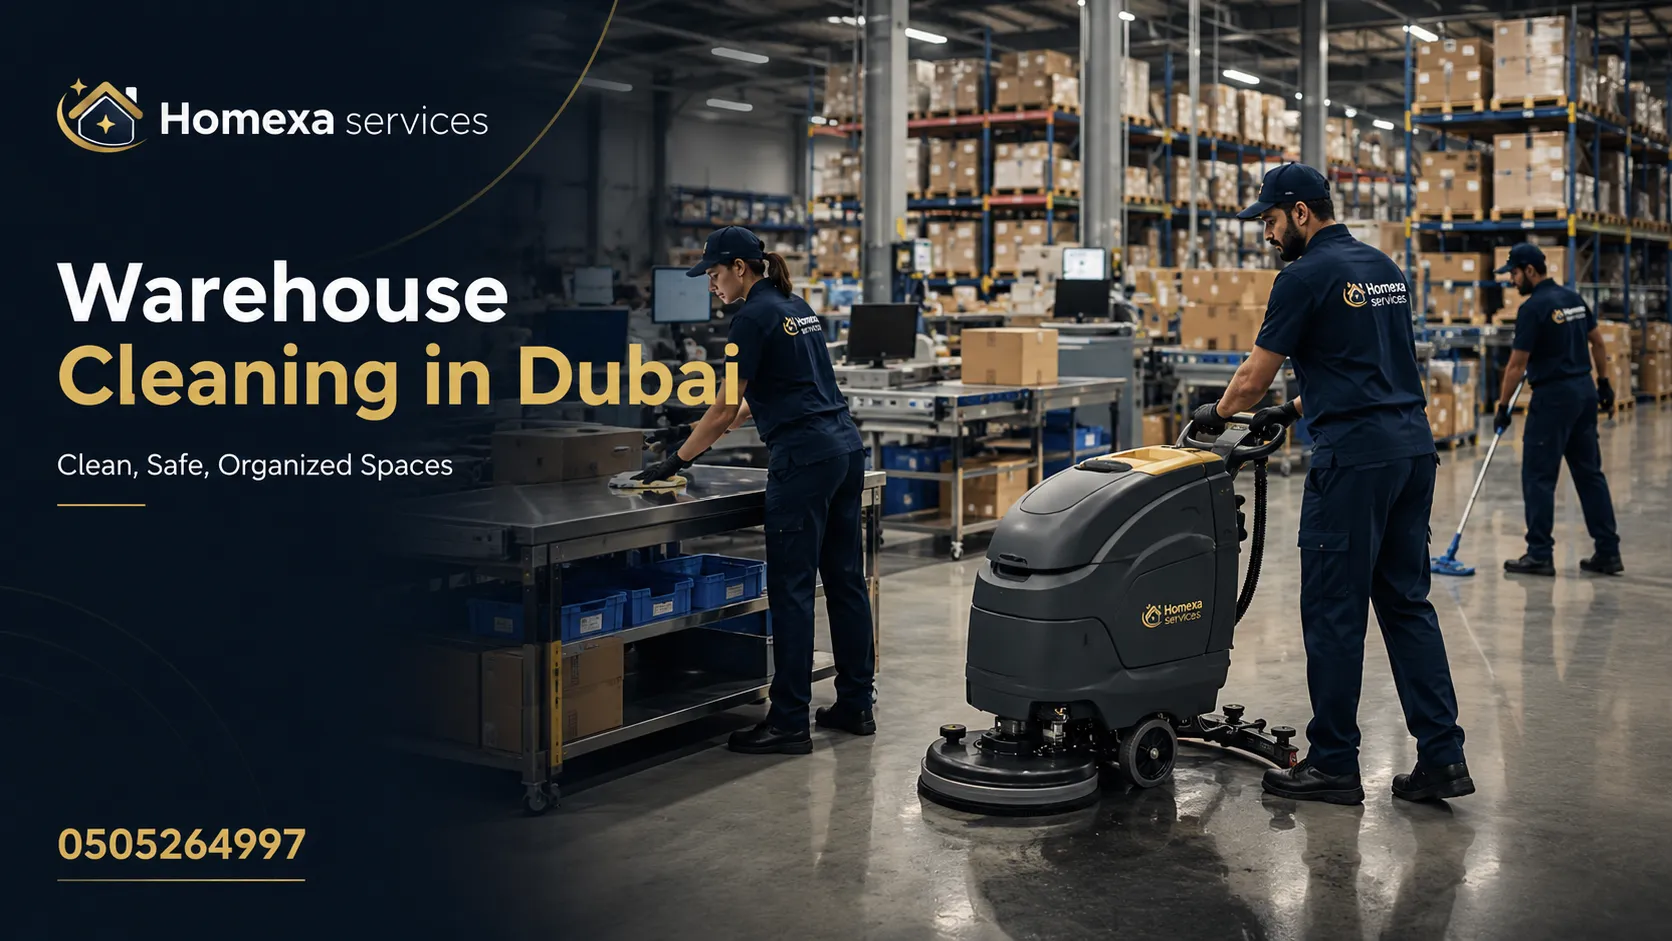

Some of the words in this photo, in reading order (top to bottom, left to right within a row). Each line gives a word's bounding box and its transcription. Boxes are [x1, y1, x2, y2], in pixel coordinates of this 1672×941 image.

[1365, 282, 1406, 296] Homexa
[1371, 293, 1407, 307] services
[1164, 600, 1203, 616] Homexa
